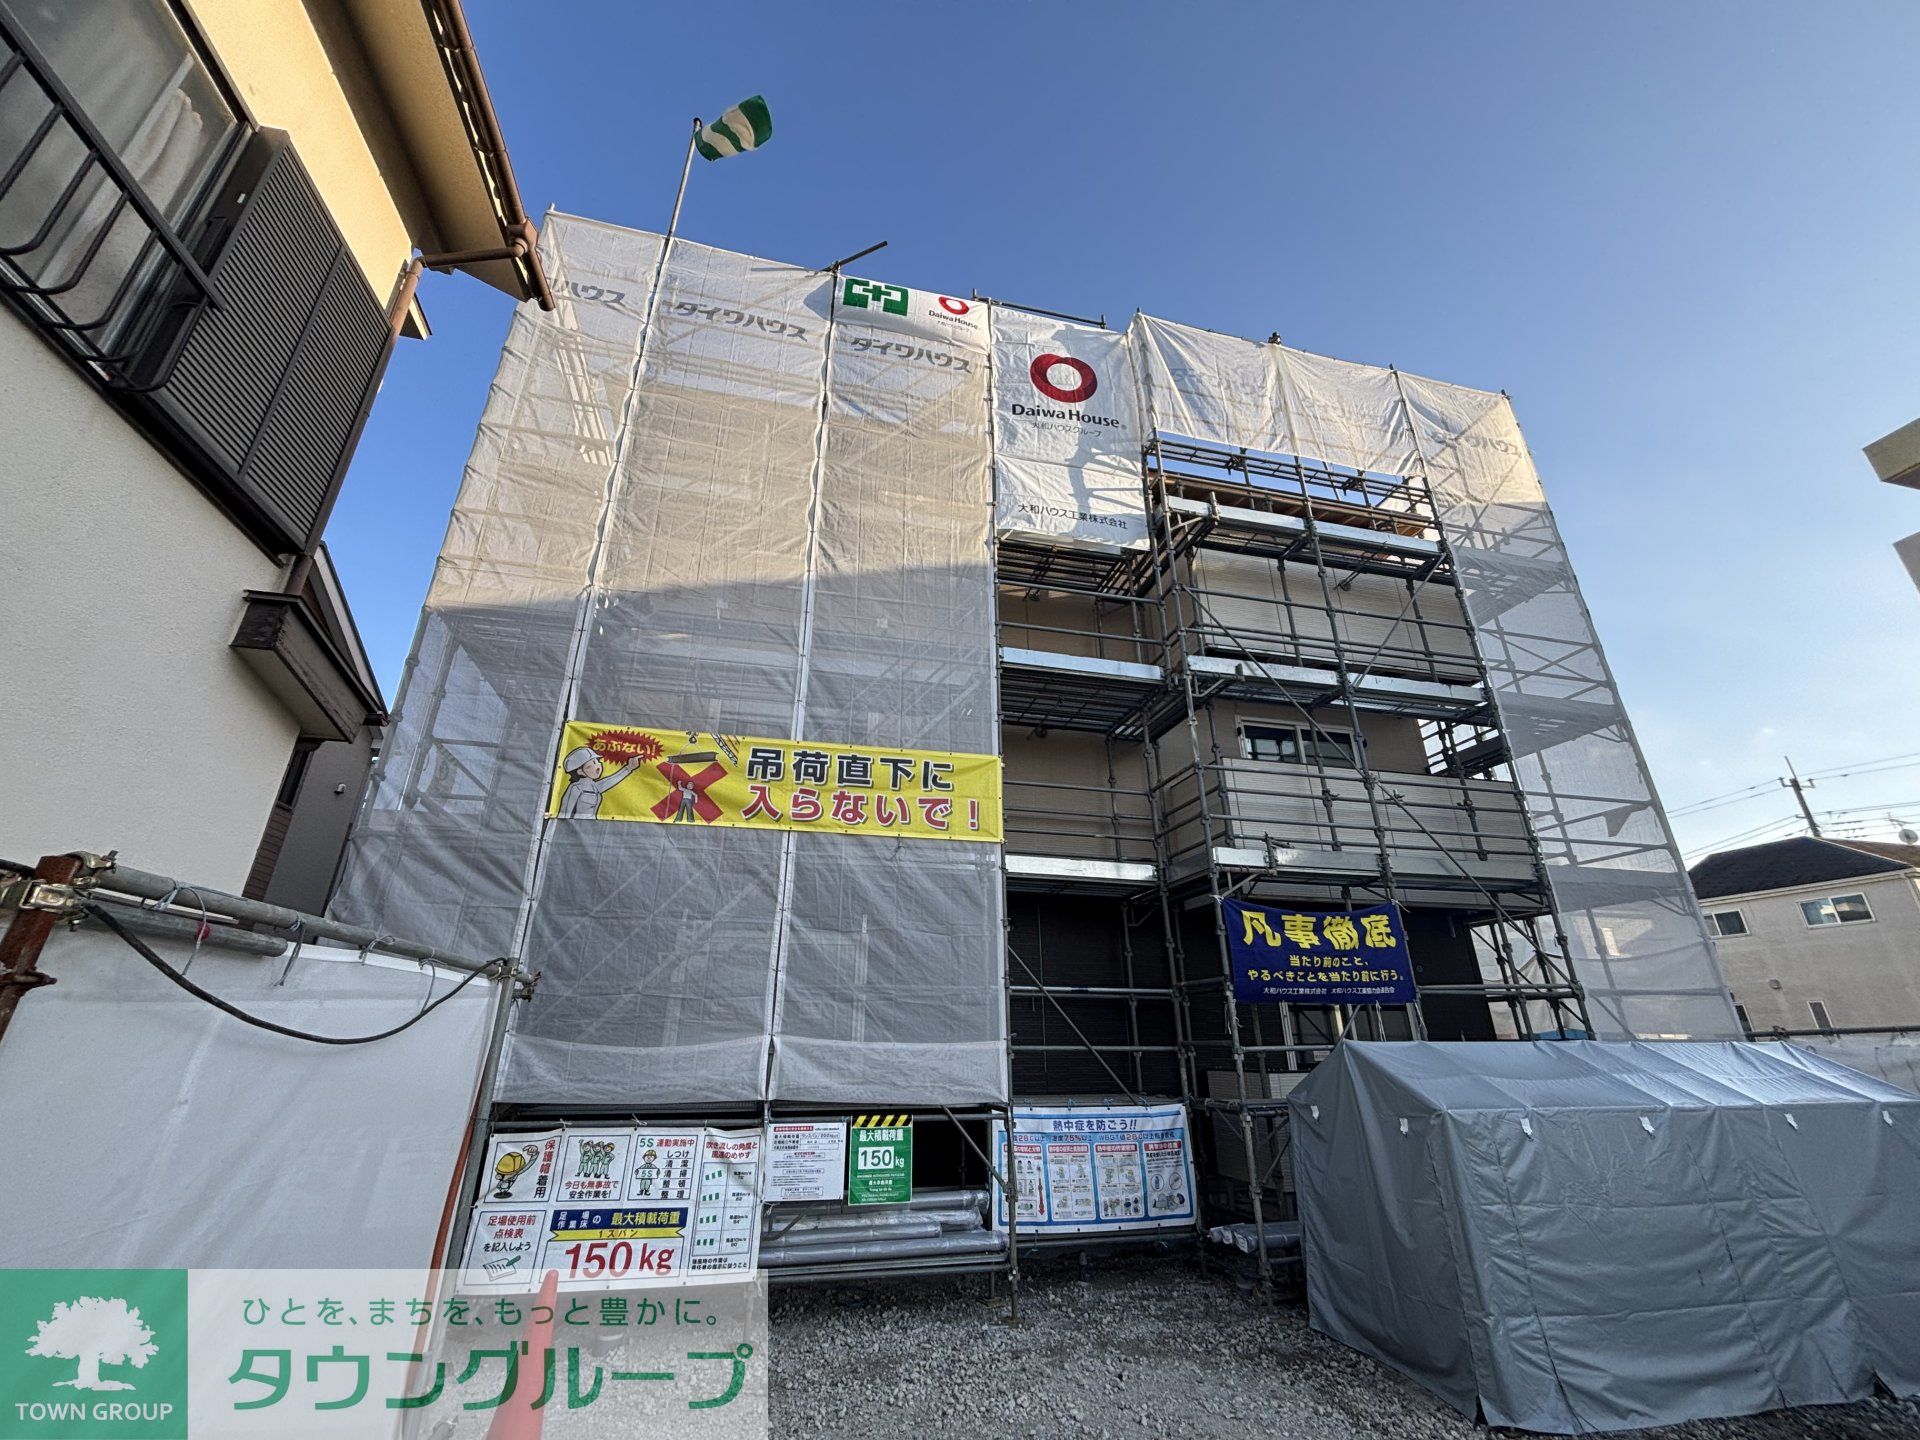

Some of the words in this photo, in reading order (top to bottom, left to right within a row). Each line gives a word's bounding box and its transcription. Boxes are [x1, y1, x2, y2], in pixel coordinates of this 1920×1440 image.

[675, 302, 807, 342] ダイワハウス
[928, 309, 954, 323] Daiwa
[954, 316, 978, 330] House
[851, 337, 972, 374] ダイワハウス
[1011, 403, 1066, 420] Daiwa
[1068, 409, 1120, 428] House
[1018, 503, 1128, 529] 大和ハウス工業株式会社
[592, 738, 656, 756] あぶない!
[745, 746, 955, 793] 吊荷直下に
[740, 785, 980, 830] 入らないで!
[1240, 909, 1397, 950] 凡事徹底
[1289, 955, 1369, 968] 当たり前のこと、
[1247, 969, 1404, 982] やるべきことを当たり前に行う。
[1052, 1119, 1138, 1132] 熱中症を防ごう!!
[859, 1129, 904, 1142] 最大積載荷重
[639, 1138, 654, 1148] 5S
[666, 1150, 690, 1159] しつけ
[860, 1149, 892, 1167] 150
[895, 1155, 905, 1168] kg
[641, 1170, 653, 1178] 5S
[564, 1180, 619, 1189] 今日も無事故で
[568, 1190, 612, 1199] 安全作業を!
[487, 1214, 537, 1227] 足場使用前
[611, 1210, 681, 1226] 最大積載荷重
[493, 1228, 525, 1240] 点検表
[482, 1241, 532, 1253] を記入しよう
[564, 1240, 633, 1279] 150
[638, 1242, 675, 1276] kg
